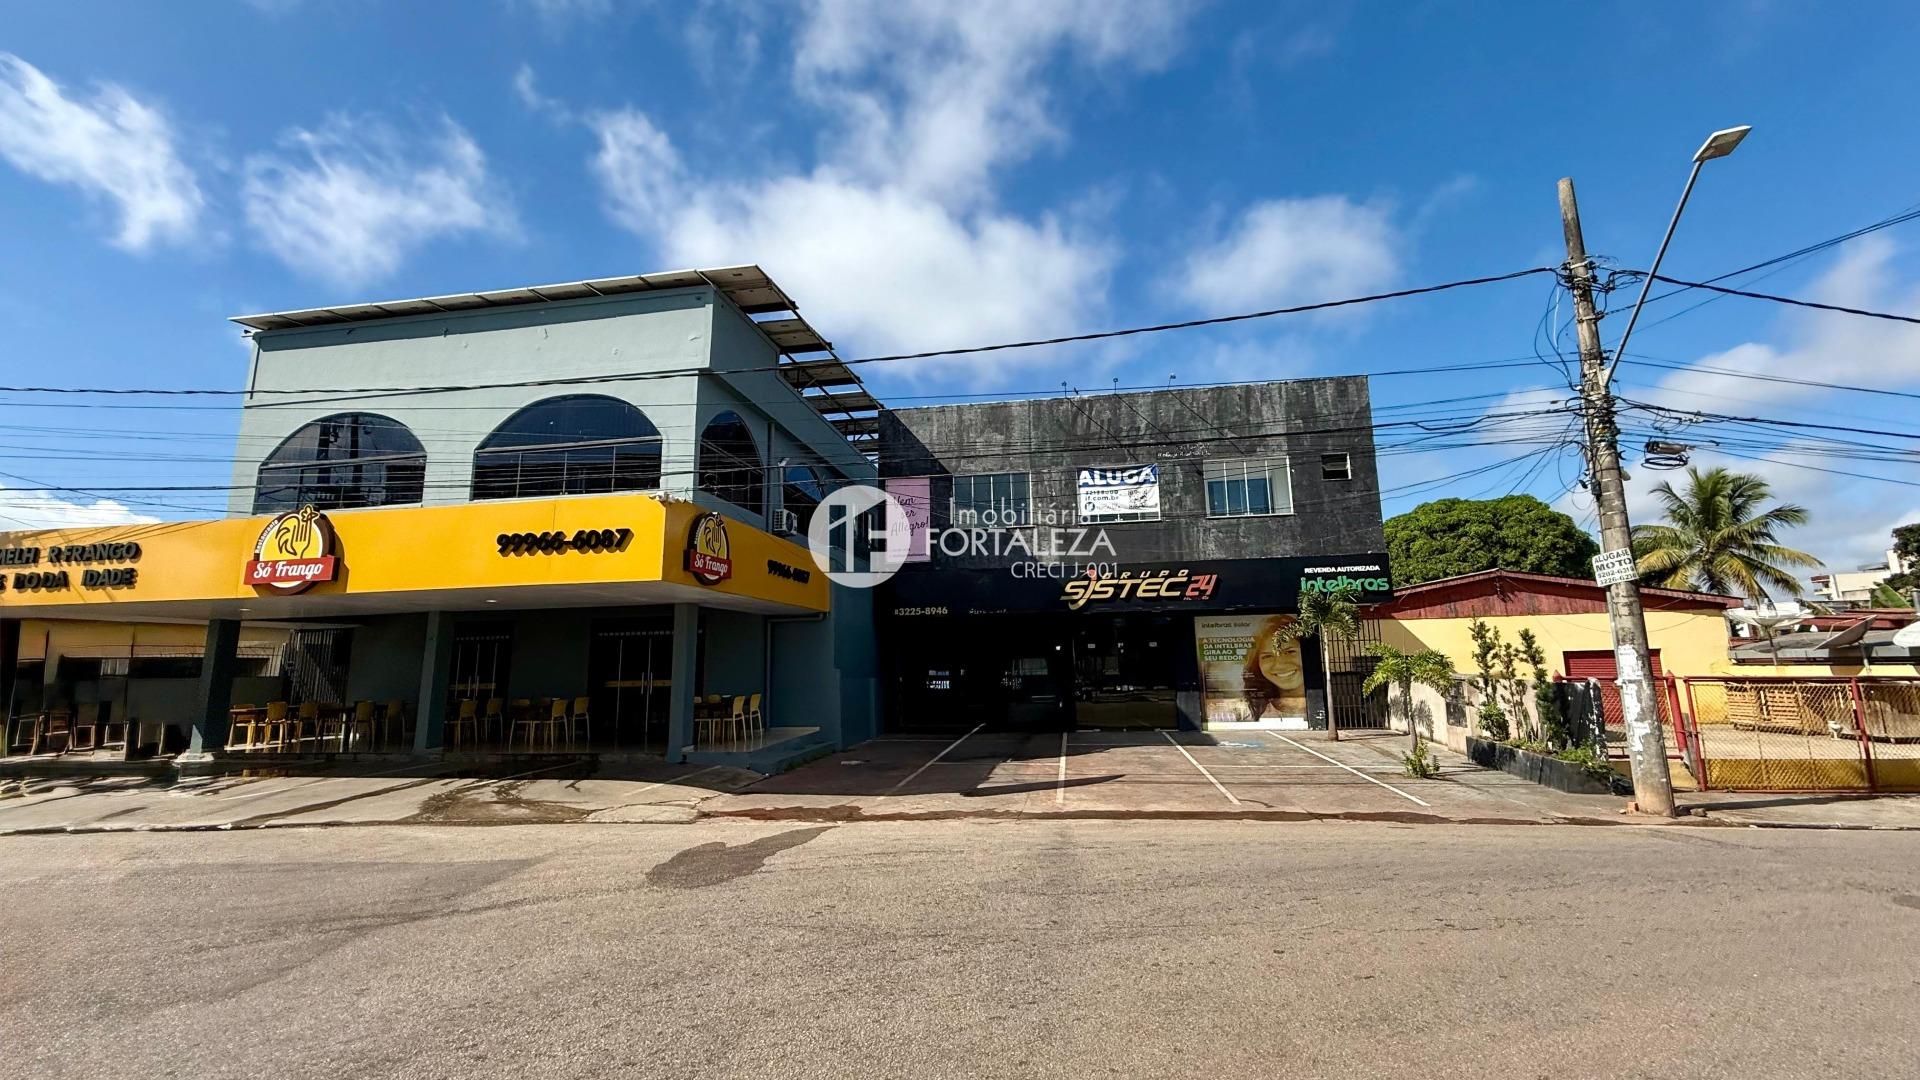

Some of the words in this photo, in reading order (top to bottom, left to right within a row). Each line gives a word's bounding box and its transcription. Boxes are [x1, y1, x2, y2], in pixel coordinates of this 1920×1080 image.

[1079, 465, 1156, 486] ALUGA
[64, 542, 141, 562] FRANGO
[497, 529, 633, 556] 99966-6087
[254, 562, 272, 578] Só
[276, 561, 323, 579] Frango
[694, 553, 704, 568] Só
[706, 556, 728, 576] Frango
[1596, 558, 1632, 572] MOTO
[1185, 574, 1217, 596] 24
[1301, 576, 1390, 593] intelbras
